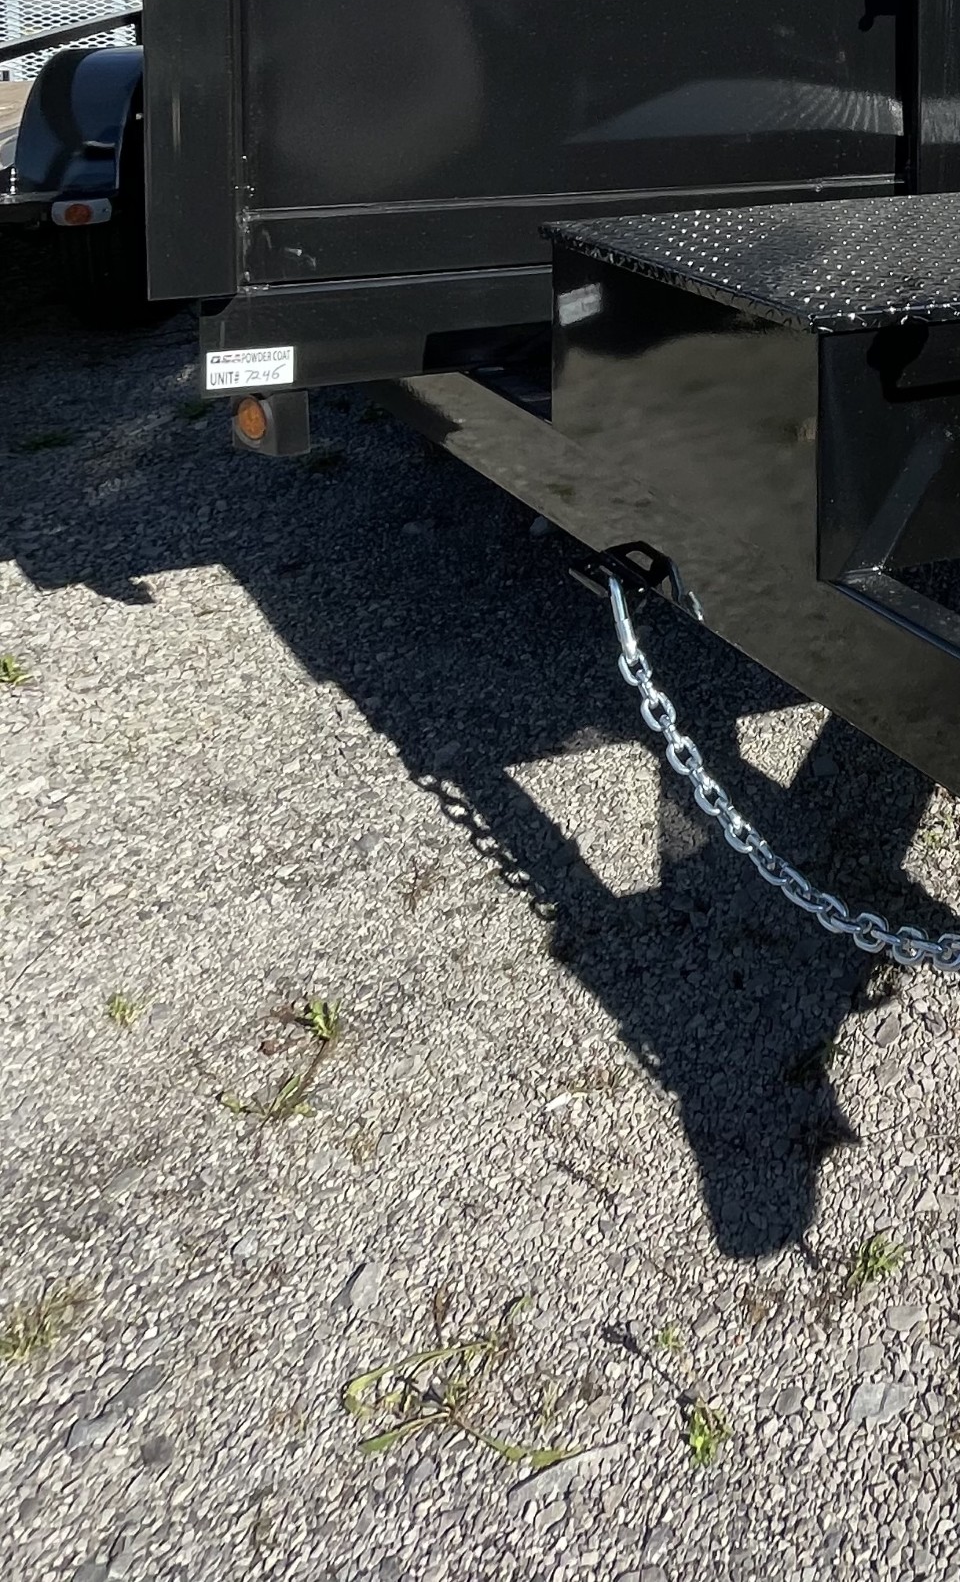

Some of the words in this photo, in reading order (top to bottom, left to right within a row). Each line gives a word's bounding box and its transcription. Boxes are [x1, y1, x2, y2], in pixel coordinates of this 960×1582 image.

[241, 351, 272, 364] POWDER
[273, 349, 291, 361] COAT
[244, 363, 286, 383] 7246
